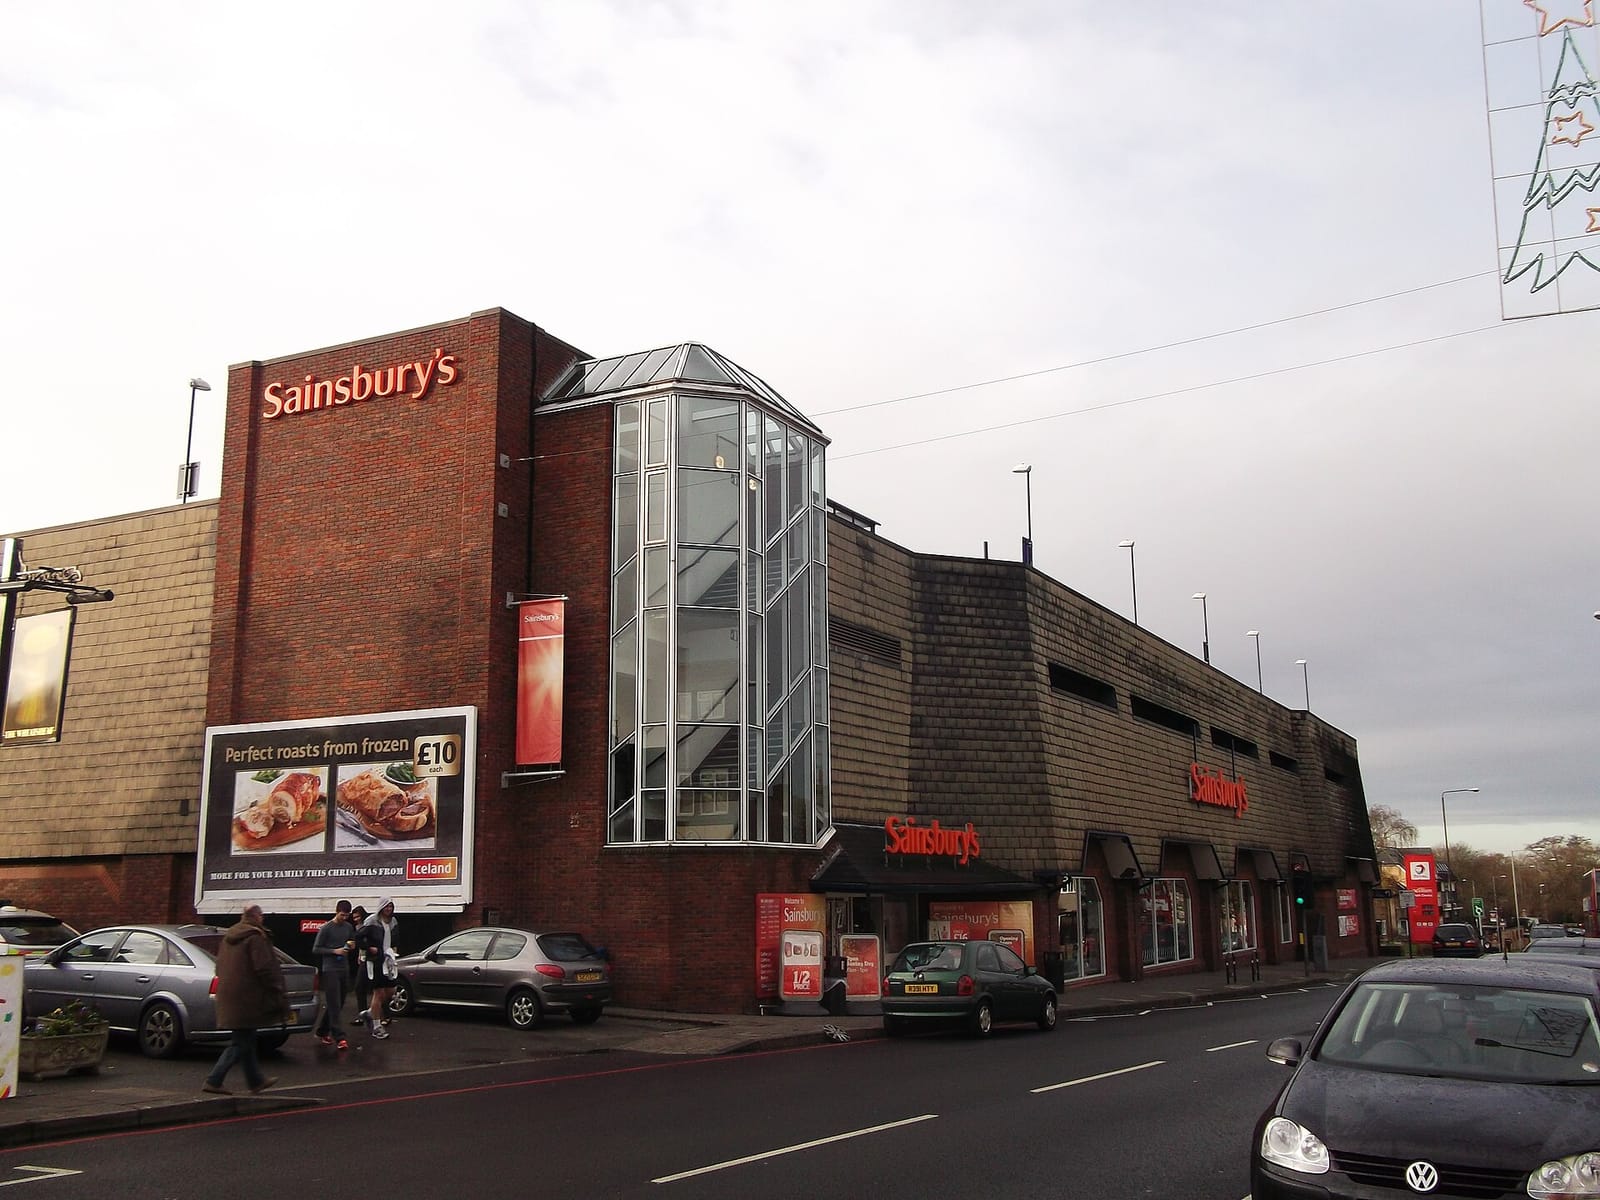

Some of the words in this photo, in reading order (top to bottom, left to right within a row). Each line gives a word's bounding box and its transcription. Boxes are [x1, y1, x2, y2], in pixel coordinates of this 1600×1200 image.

[262, 347, 459, 419] Sainsbury's
[524, 613, 560, 623] Sainsbury's
[225, 746, 274, 763] Perfect
[277, 744, 320, 760] roasts
[323, 741, 358, 758] from
[361, 738, 409, 755] frozen
[417, 741, 457, 766] £10
[1190, 762, 1249, 818] Sainsbury's
[885, 815, 980, 865] Sainsbury's
[210, 872, 232, 880] MORE
[234, 871, 250, 879] FOR
[252, 870, 273, 879] YOUR
[275, 869, 304, 878] FAMILY
[306, 869, 326, 877] THIS
[327, 867, 377, 876] CHRISTMAS
[379, 867, 404, 876] FROM
[412, 862, 452, 875] Iceland
[793, 970, 810, 984] 1/2
